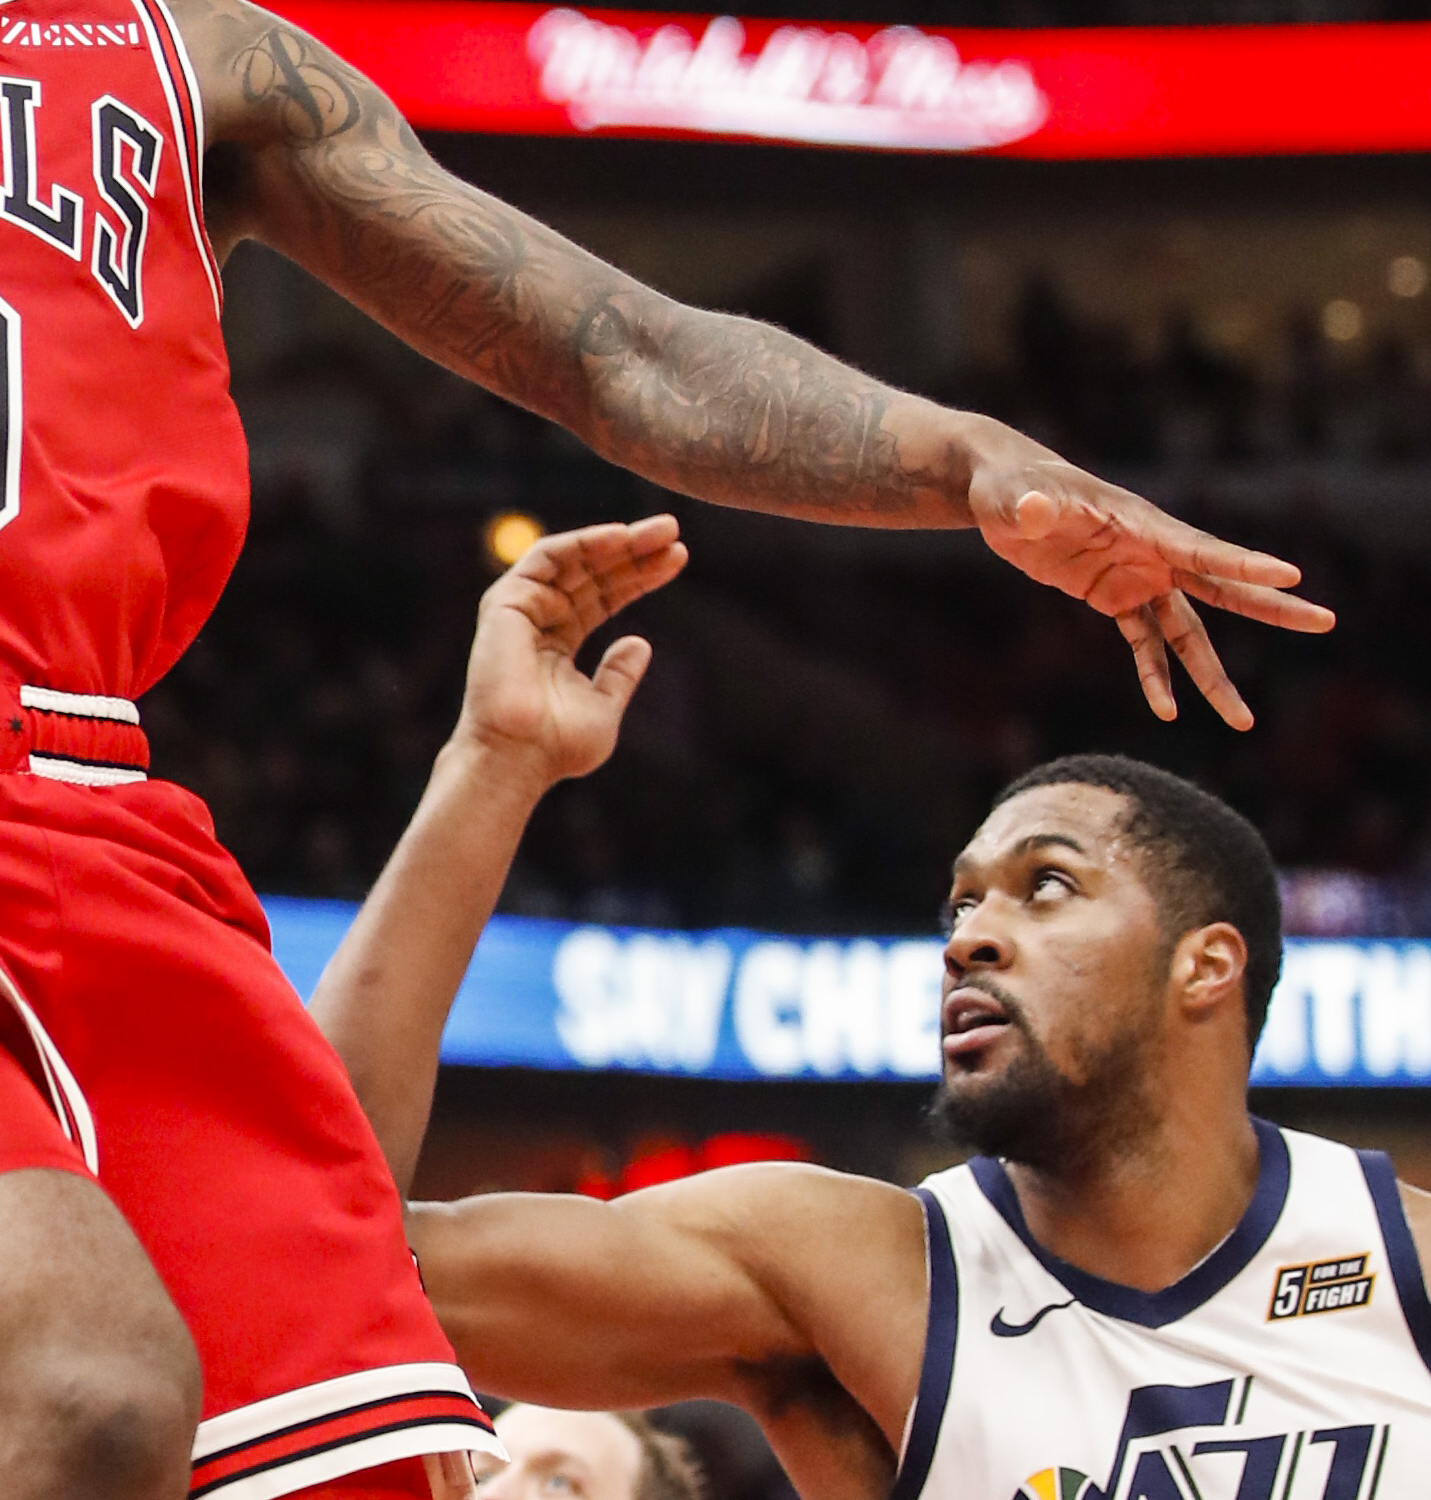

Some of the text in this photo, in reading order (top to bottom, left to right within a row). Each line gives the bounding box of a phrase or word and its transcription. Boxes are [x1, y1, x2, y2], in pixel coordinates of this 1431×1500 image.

[1, 15, 140, 47] ZENNI
[552, 925, 735, 1074] SAY
[1273, 1270, 1304, 1317] 5
[1305, 1280, 1370, 1312] FIGHT
